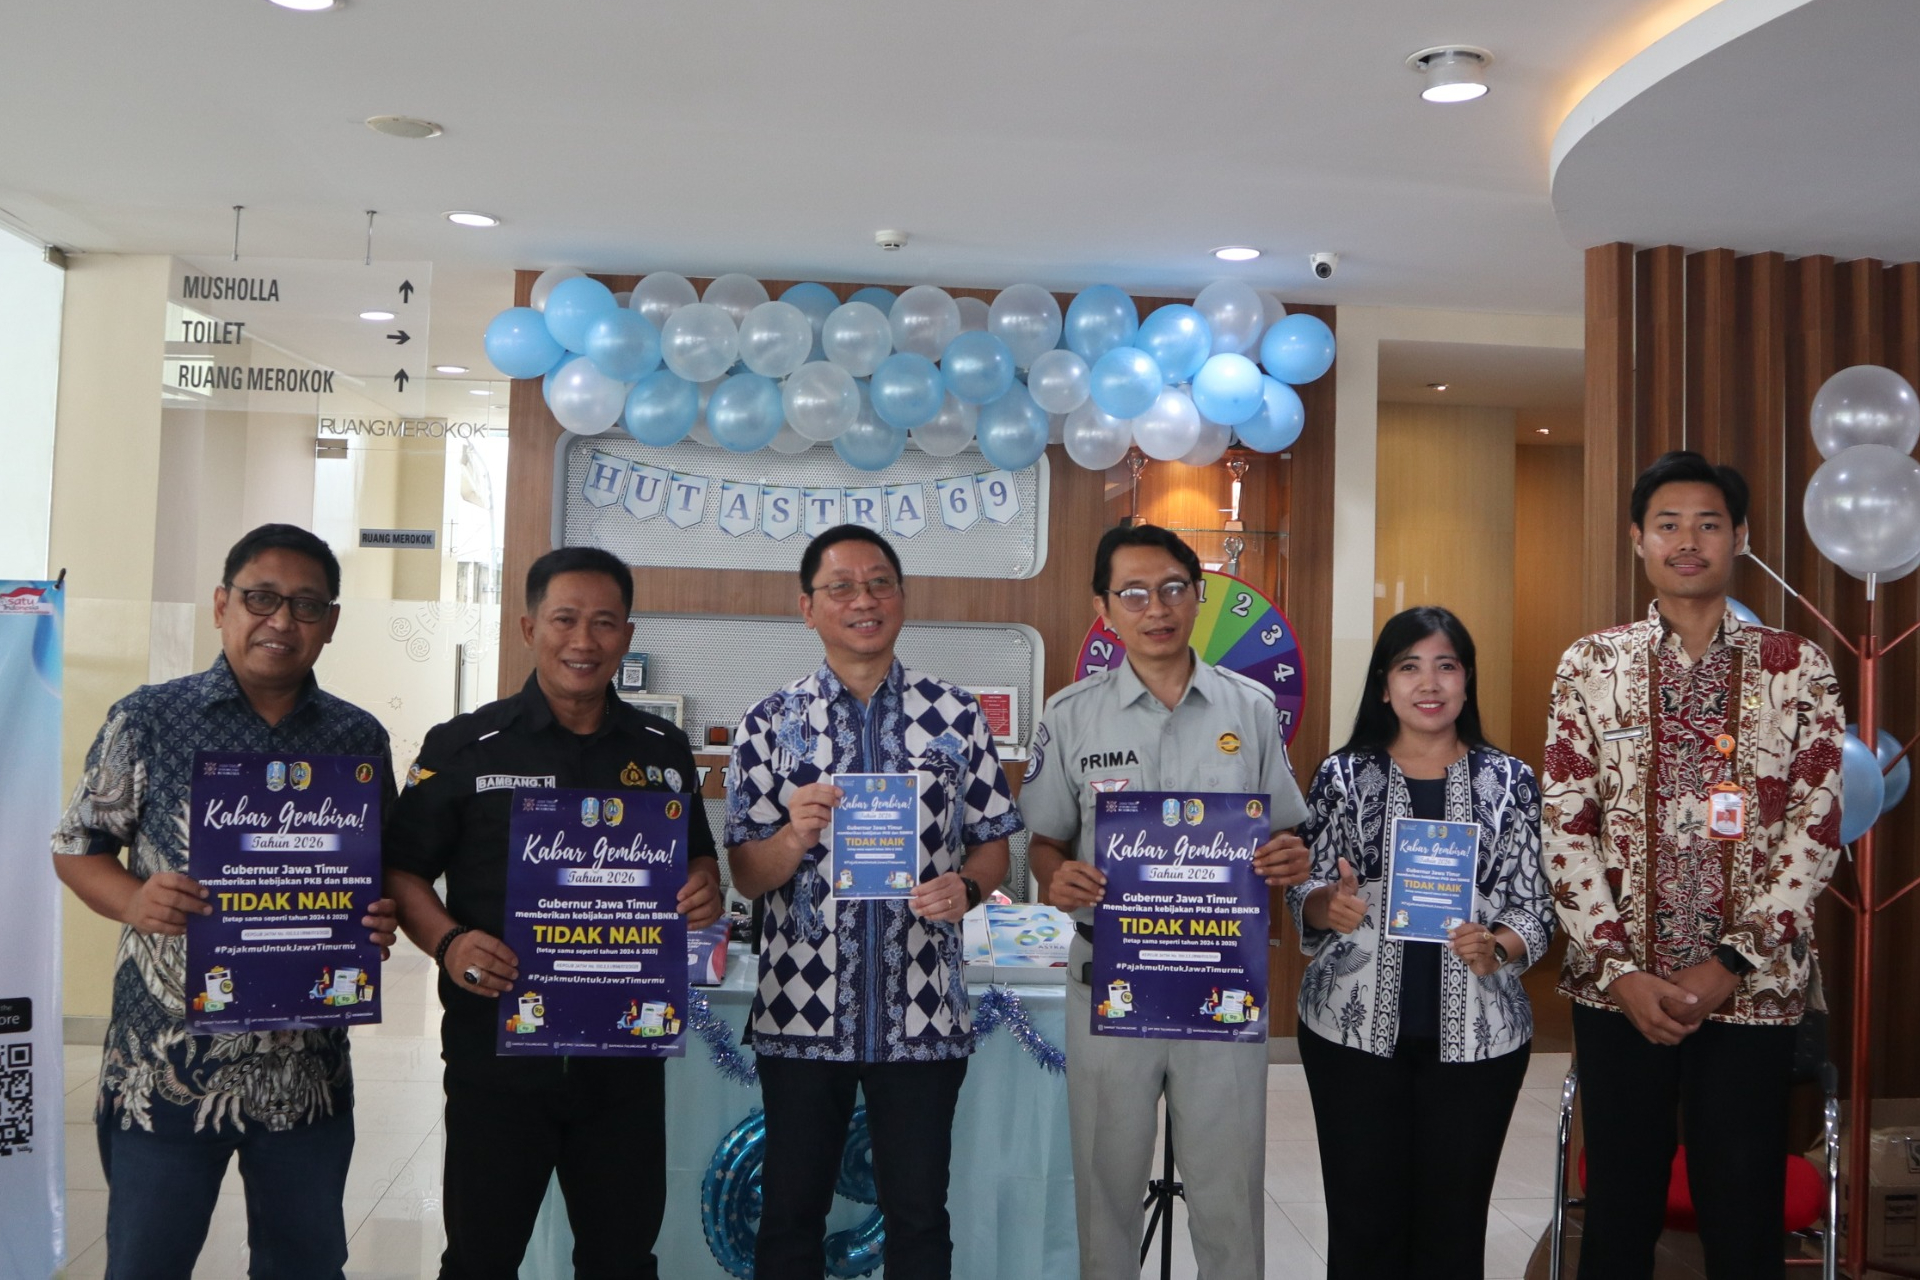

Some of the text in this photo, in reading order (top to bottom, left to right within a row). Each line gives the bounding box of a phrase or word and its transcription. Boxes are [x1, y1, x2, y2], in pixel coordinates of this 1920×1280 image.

[182, 275, 280, 302] MUSHOLLA
[182, 320, 246, 345] TOILET
[178, 364, 335, 393] RUANG MEROKOK
[589, 461, 1009, 526] HUT ASTRA 69
[362, 533, 432, 545] RUANG MEROKOK
[1231, 592, 1254, 617] 2
[1260, 623, 1284, 646] 3
[1085, 639, 1114, 675] 12
[1273, 663, 1296, 682] 4
[1081, 749, 1140, 773] PRIMA
[203, 795, 368, 838] Kabar Gembira!
[251, 836, 324, 849] Tahun 2026
[845, 837, 906, 847] TIDAK NAIK
[522, 830, 677, 872] Kabar Gembira!
[1106, 829, 1259, 870] Kabar Gembira!
[222, 863, 349, 875] Gubernur Jawa Timur
[1149, 867, 1216, 880] Tahun 2026
[198, 877, 373, 887] memberikan kebijakan PKB dan BBNKB
[567, 871, 636, 884] Tahun 2026
[1403, 879, 1462, 893] TIDAK NAIK
[217, 891, 354, 912] TIDAK NAIK
[537, 898, 658, 910] Gubernur Jawa Timur
[1122, 893, 1238, 905] Gubernur Jawa Timur
[515, 911, 680, 921] memberikan kebijakan PKB dan BBNKB
[1103, 903, 1261, 915] memberikan kebijakan PKB dan BBNKB
[263, 914, 288, 923] seperti
[288, 914, 308, 922] tahun
[1118, 917, 1242, 937] TIDAK NAIK
[532, 925, 663, 945] TIDAK NAIK
[1014, 925, 1061, 947] 69
[1122, 937, 1142, 946] (tetap
[1159, 938, 1180, 947] seperti
[214, 941, 357, 956] #PajakmuUntukJawaTimurmu
[575, 947, 599, 956] seperti
[1116, 962, 1245, 974] #PajakmuUntukJawaTimurmu
[527, 974, 665, 985] #PajakmuUntukJawaTimurmu
